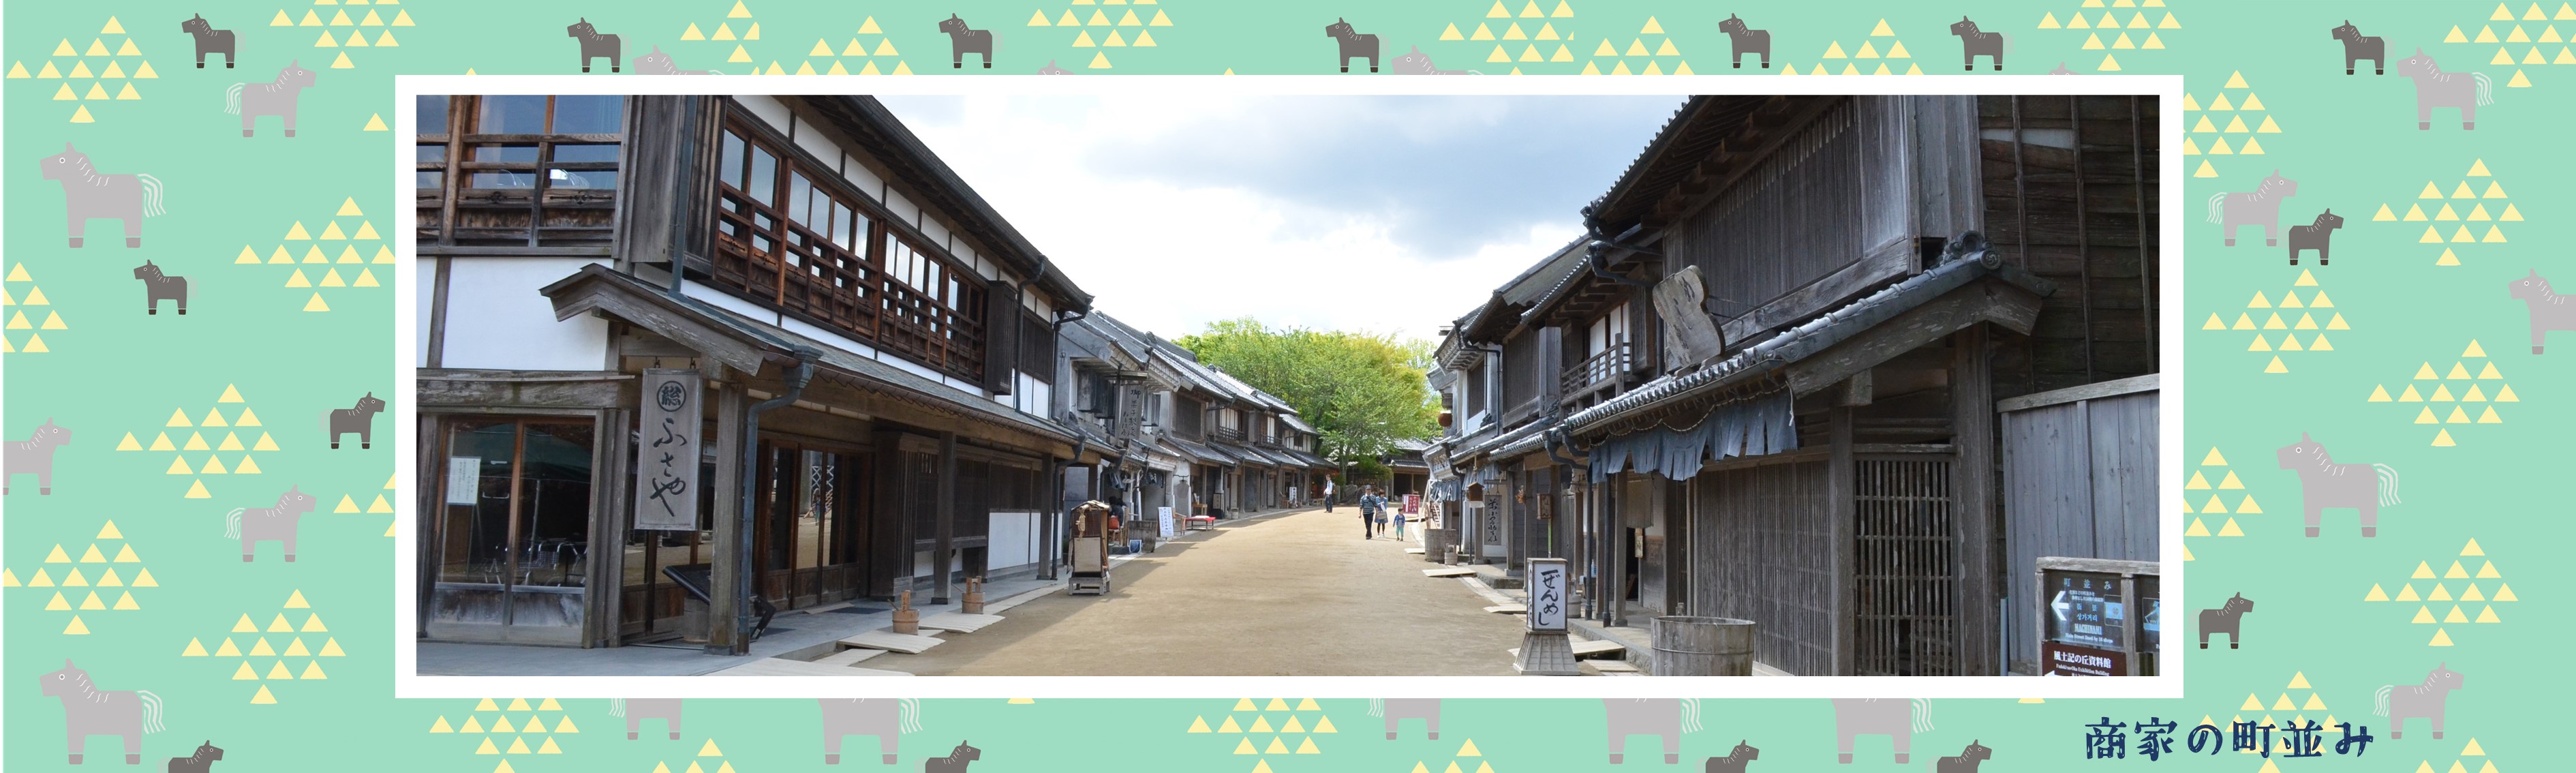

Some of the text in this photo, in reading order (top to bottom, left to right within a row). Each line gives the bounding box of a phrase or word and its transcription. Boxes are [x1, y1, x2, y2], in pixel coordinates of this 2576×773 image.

[650, 417, 687, 517] ふさや
[2064, 577, 2112, 590] 町並み
[2076, 613, 2098, 622] 상가거리
[2074, 623, 2102, 635] MACHINAMI
[2054, 650, 2111, 669] 風土記の丘資料館
